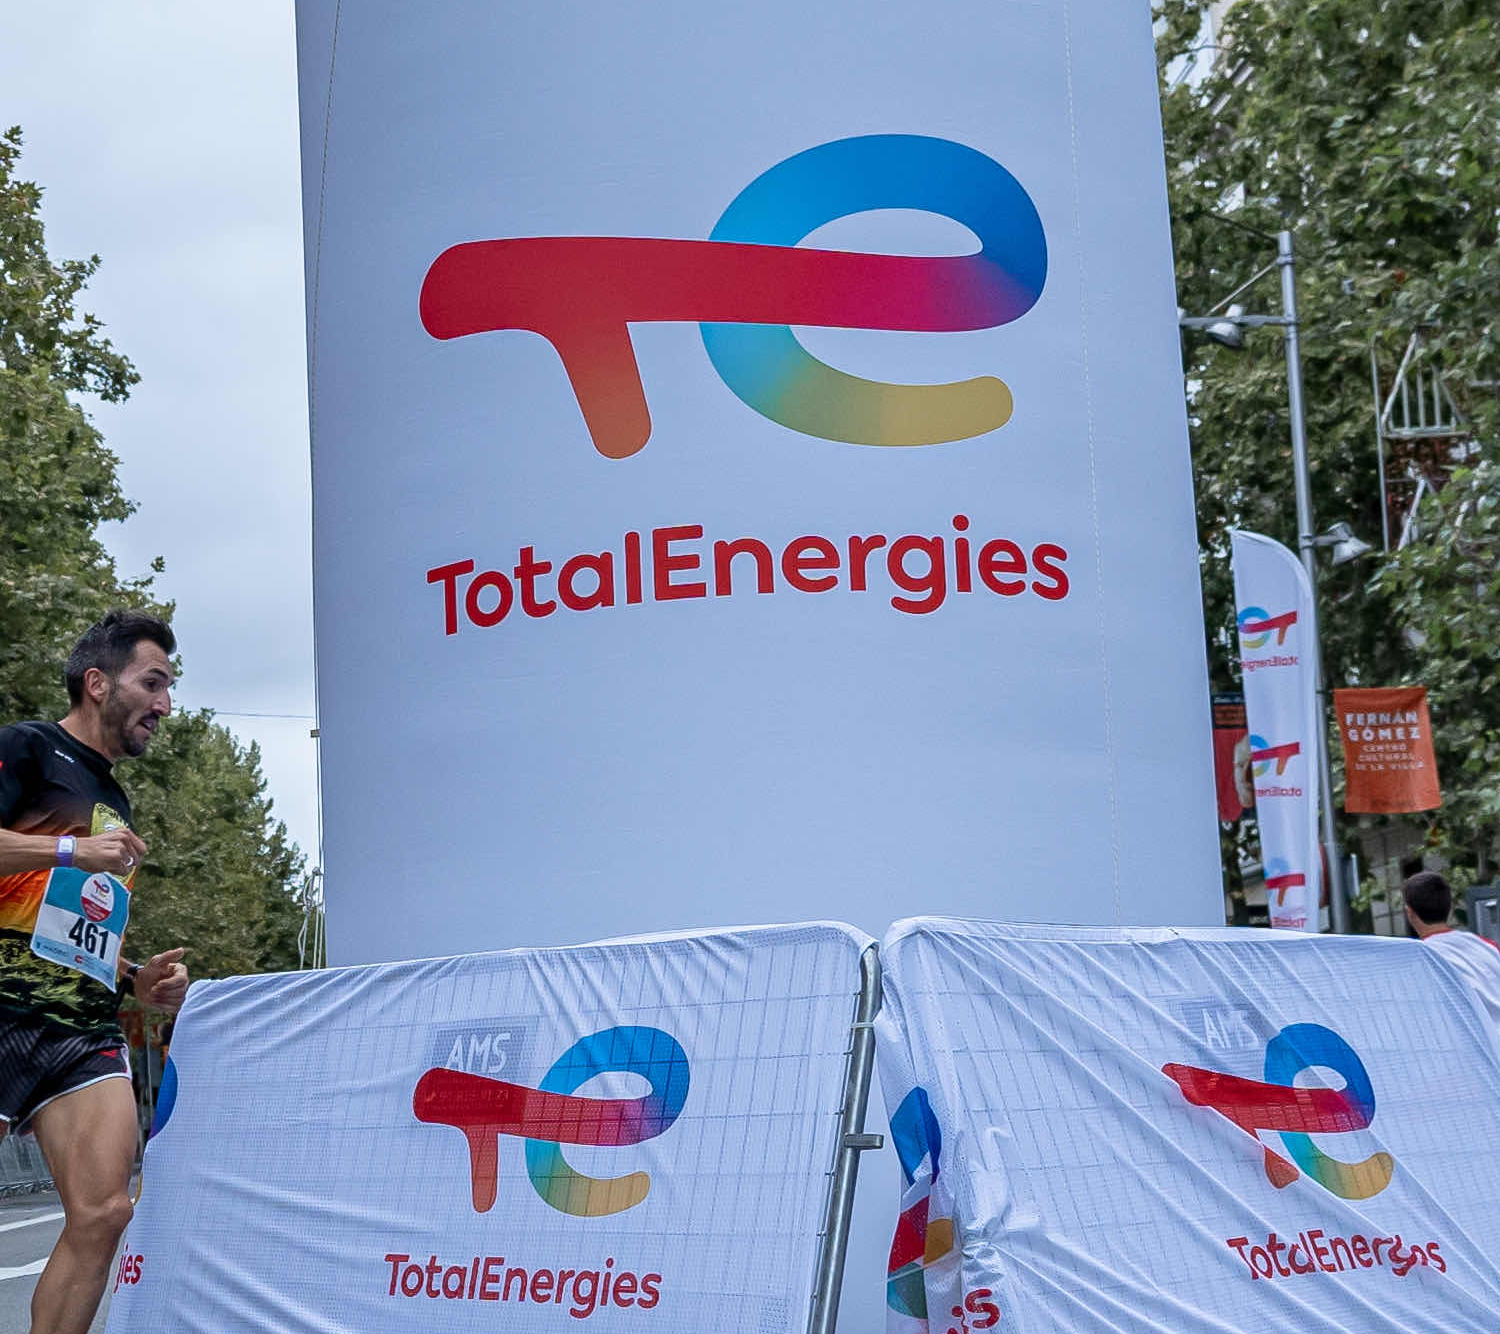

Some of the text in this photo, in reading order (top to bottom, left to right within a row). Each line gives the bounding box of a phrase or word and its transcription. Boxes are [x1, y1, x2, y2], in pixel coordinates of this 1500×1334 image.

[426, 514, 1070, 636] TotalEnergies
[1345, 710, 1418, 726] FERNÁN
[1348, 726, 1421, 742] GÓMEZ
[68, 917, 109, 960] 461
[444, 1032, 512, 1074] AMS
[1226, 1229, 1447, 1280] TotalEnergs
[385, 1254, 662, 1319] TotalEnergies
